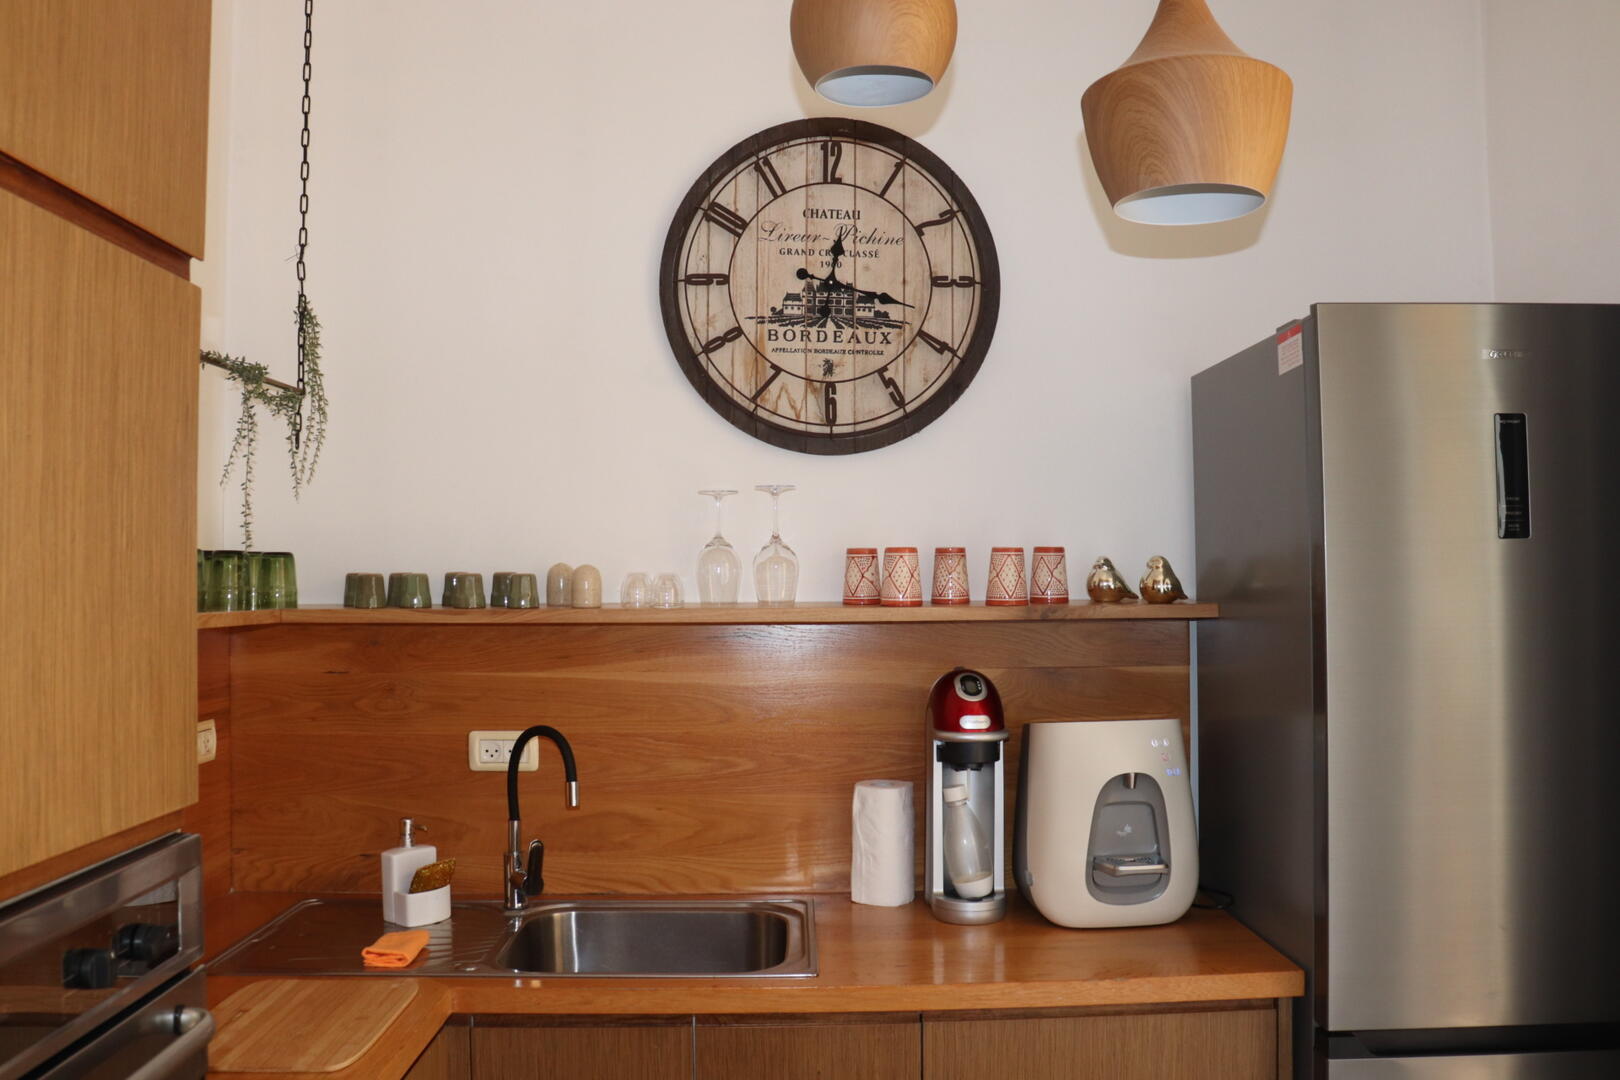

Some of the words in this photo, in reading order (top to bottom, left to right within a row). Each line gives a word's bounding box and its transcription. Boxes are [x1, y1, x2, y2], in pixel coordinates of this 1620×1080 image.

[820, 141, 843, 184] 12
[754, 158, 787, 198] 11
[879, 159, 905, 198] 1
[704, 202, 748, 237] 10
[802, 208, 861, 220] CHATEAU
[916, 210, 955, 237] 2
[779, 248, 815, 256] GRAND
[686, 272, 730, 286] 9
[932, 275, 975, 288] 3
[703, 327, 743, 355] 8
[767, 328, 892, 345] BORDEAUX
[919, 330, 957, 356] 4
[771, 347, 812, 355] APPELLATION
[751, 363, 782, 402] 7
[877, 366, 905, 407] 5
[824, 381, 838, 426] 6
